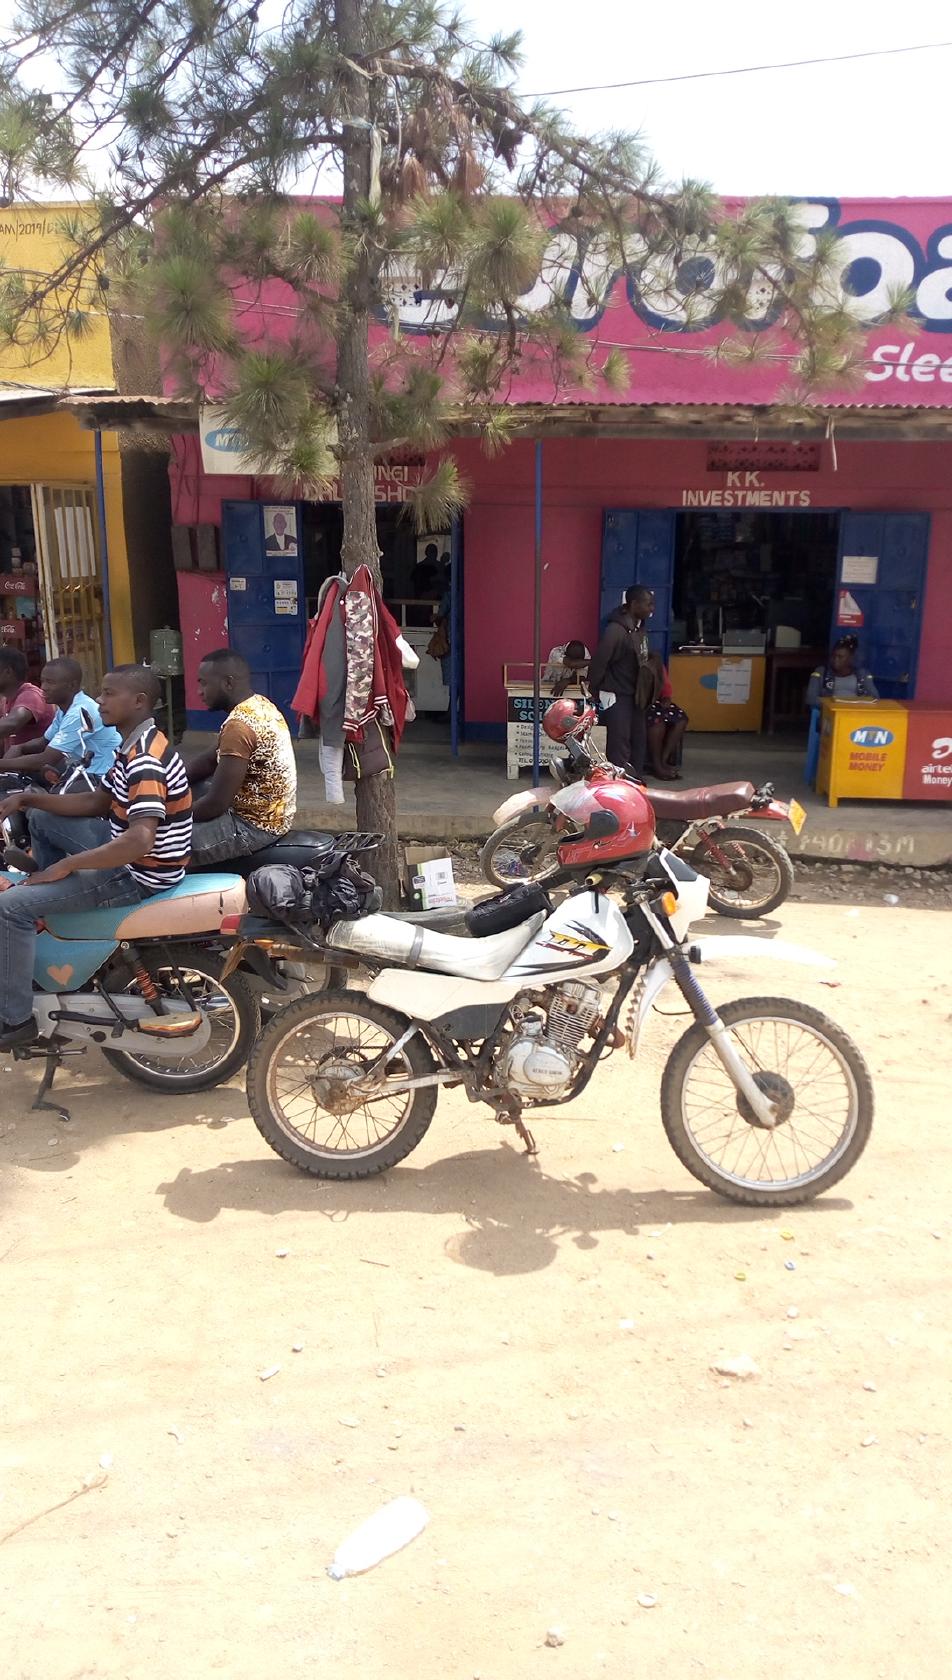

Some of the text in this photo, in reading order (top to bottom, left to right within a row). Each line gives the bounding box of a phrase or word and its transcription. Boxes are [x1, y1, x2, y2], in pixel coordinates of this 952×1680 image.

[682, 490, 811, 506] INVESTMENTS
[853, 730, 889, 745] MTN
[849, 752, 888, 762] MOBILE
[848, 762, 886, 772] MONEY
[922, 774, 952, 788] Money
